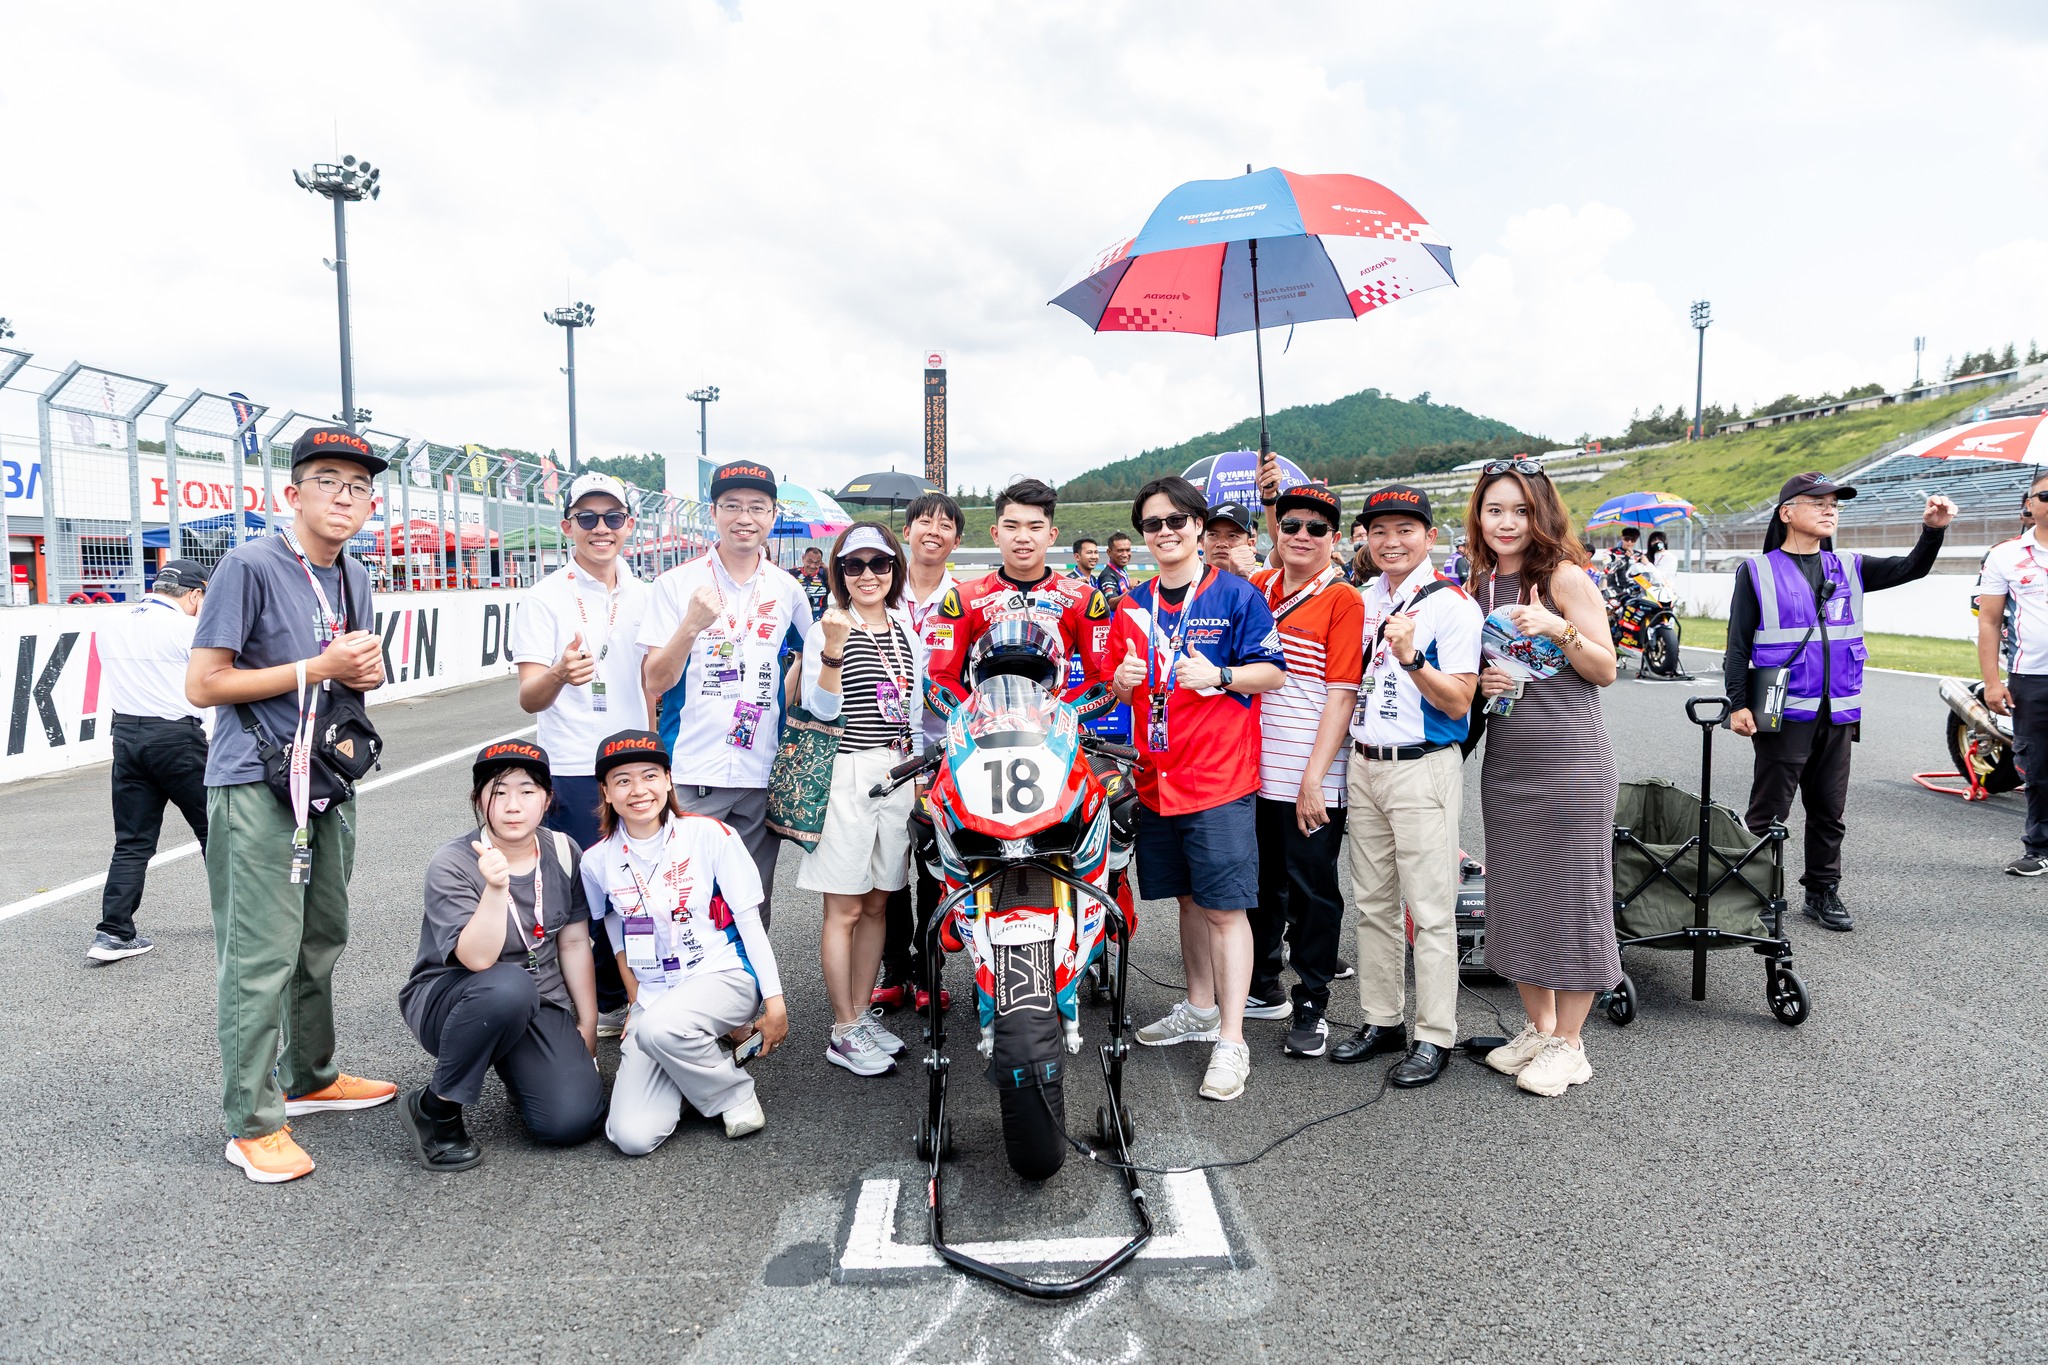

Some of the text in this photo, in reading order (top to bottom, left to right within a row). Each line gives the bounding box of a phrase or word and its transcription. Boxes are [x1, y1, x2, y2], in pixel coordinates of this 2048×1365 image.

[1177, 203, 1268, 222] Honda Racing
[1200, 211, 1256, 224] Vietnam
[1343, 205, 1387, 216] HONDA
[926, 377, 940, 385] Lap
[939, 386, 945, 394] 0
[933, 396, 945, 404] 57
[933, 419, 945, 427] 44
[314, 431, 369, 454] Honda
[720, 465, 767, 480] Honda
[1227, 470, 1256, 479] YAMAH
[151, 477, 281, 513] HONDA
[1291, 487, 1337, 506] Honda
[1369, 489, 1420, 507] Honda
[397, 527, 432, 537] Hnda
[1275, 595, 1300, 616] JAPAN
[991, 611, 1060, 623] HONDA
[1264, 647, 1284, 656] HON
[758, 671, 772, 680] RK
[1076, 691, 1116, 715] HONDA
[485, 743, 541, 760] Honda
[603, 737, 657, 757] Honda
[983, 757, 1046, 816] 18
[1084, 905, 1103, 919] RK
[995, 921, 1051, 939] idemitsu
[1013, 1062, 1057, 1089] F F
